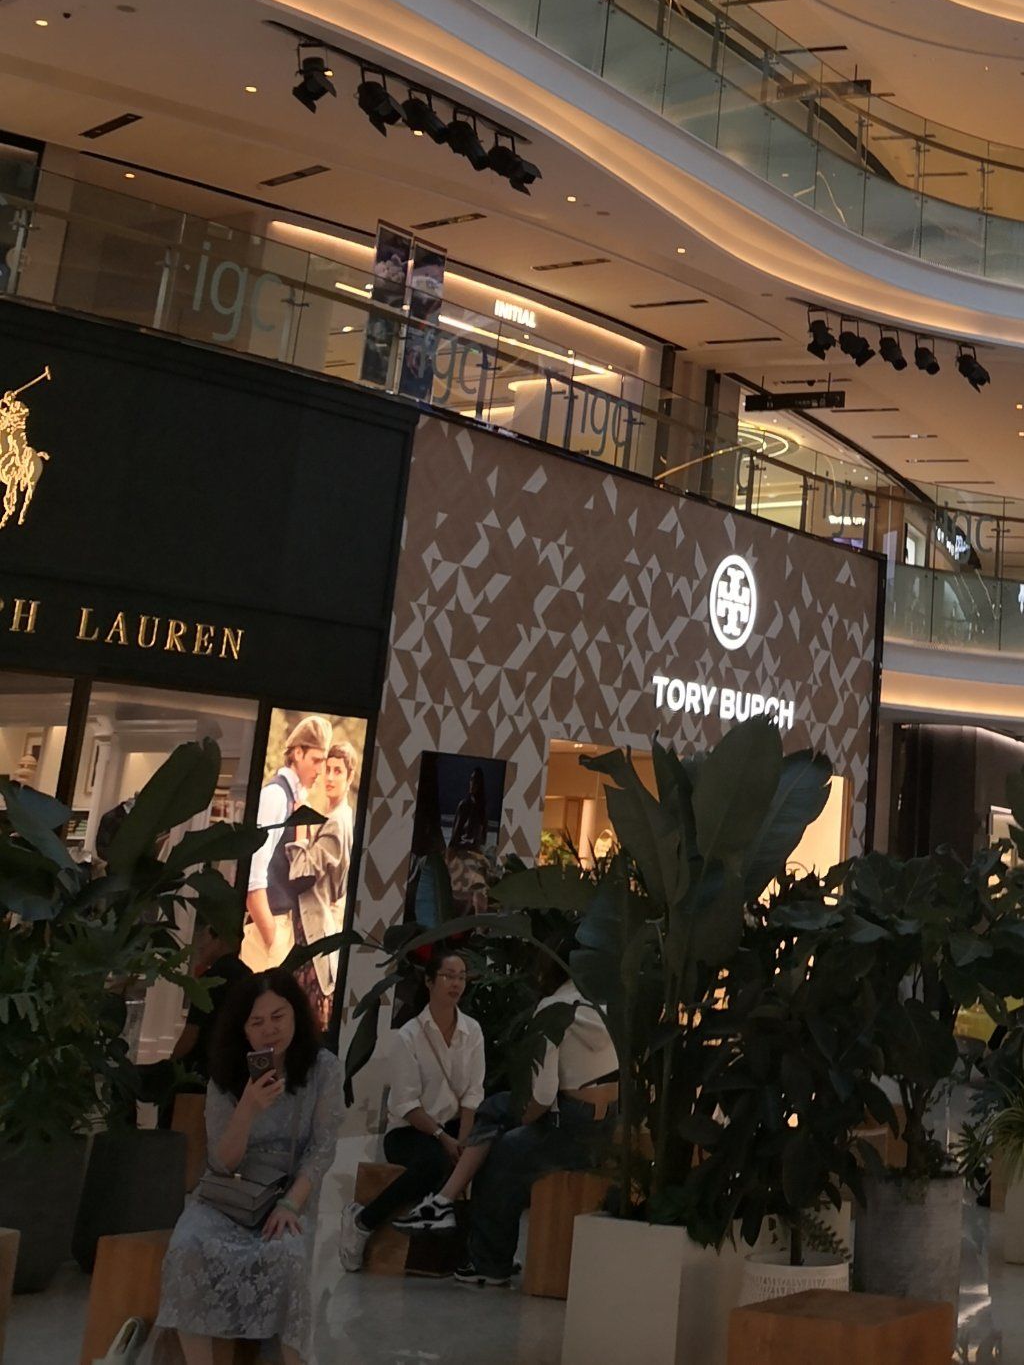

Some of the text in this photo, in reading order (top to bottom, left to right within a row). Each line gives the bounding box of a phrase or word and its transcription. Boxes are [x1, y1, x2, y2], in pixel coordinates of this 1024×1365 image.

[494, 298, 537, 329] INITIAL
[76, 606, 245, 660] LAUREN
[652, 675, 717, 716] TORY
